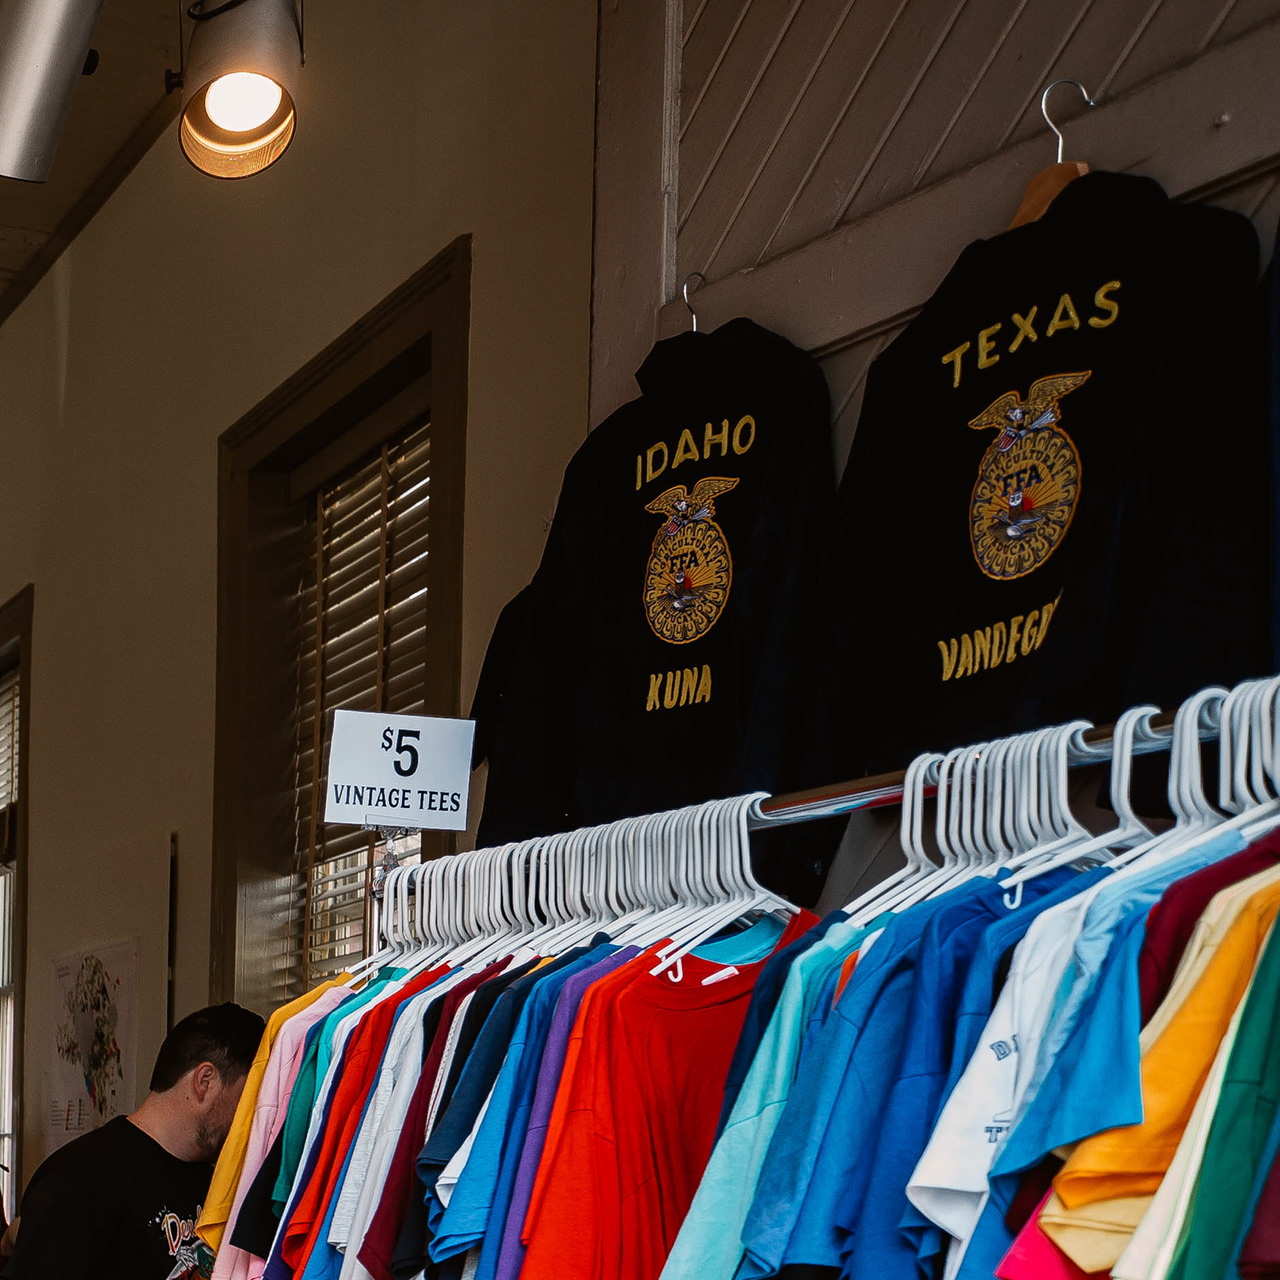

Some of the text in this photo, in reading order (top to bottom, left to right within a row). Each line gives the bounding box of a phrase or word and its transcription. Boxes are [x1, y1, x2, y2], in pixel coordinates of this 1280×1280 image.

[942, 281, 1122, 388] TEXAS
[635, 415, 756, 491] IDAHO
[1001, 464, 1042, 497] FFA
[670, 550, 700, 573] FFA
[647, 664, 712, 711] KUNA
[381, 727, 421, 777] $5
[334, 784, 461, 812] VINTAGE TEES
